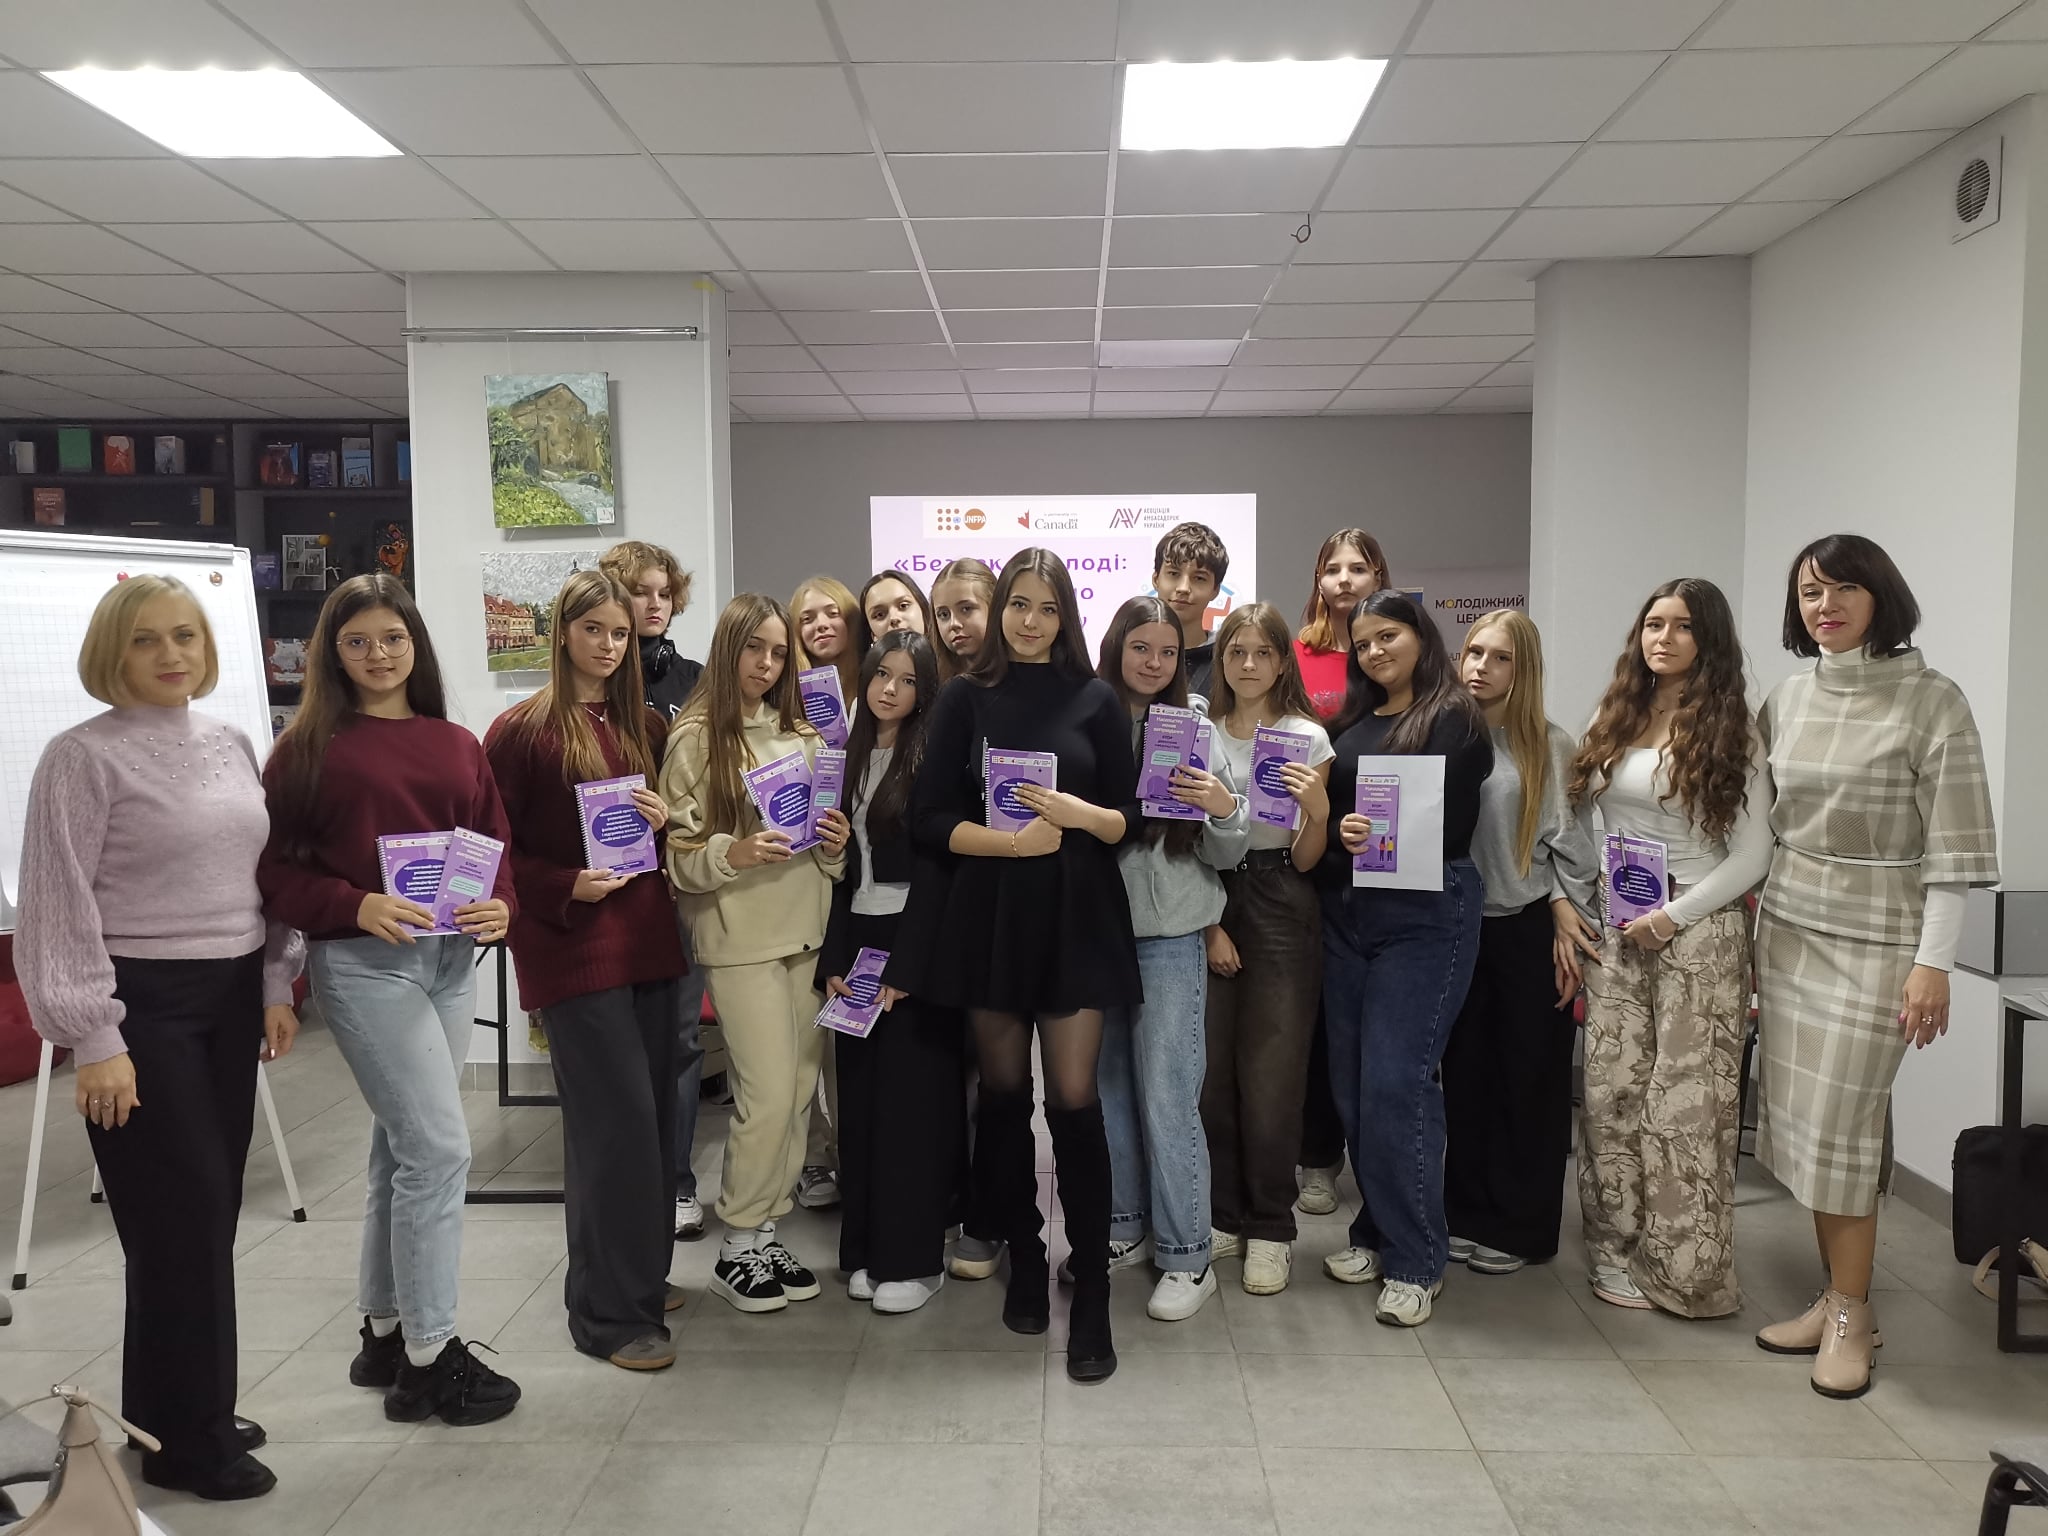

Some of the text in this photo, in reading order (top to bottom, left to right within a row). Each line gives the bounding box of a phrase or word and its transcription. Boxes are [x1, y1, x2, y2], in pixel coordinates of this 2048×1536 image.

[1034, 518, 1079, 530] Canada
[1066, 553, 1127, 573] лоді:
[1435, 594, 1525, 609] МОЛОДІЖНИЙ
[1456, 613, 1487, 624] ЦЕН
